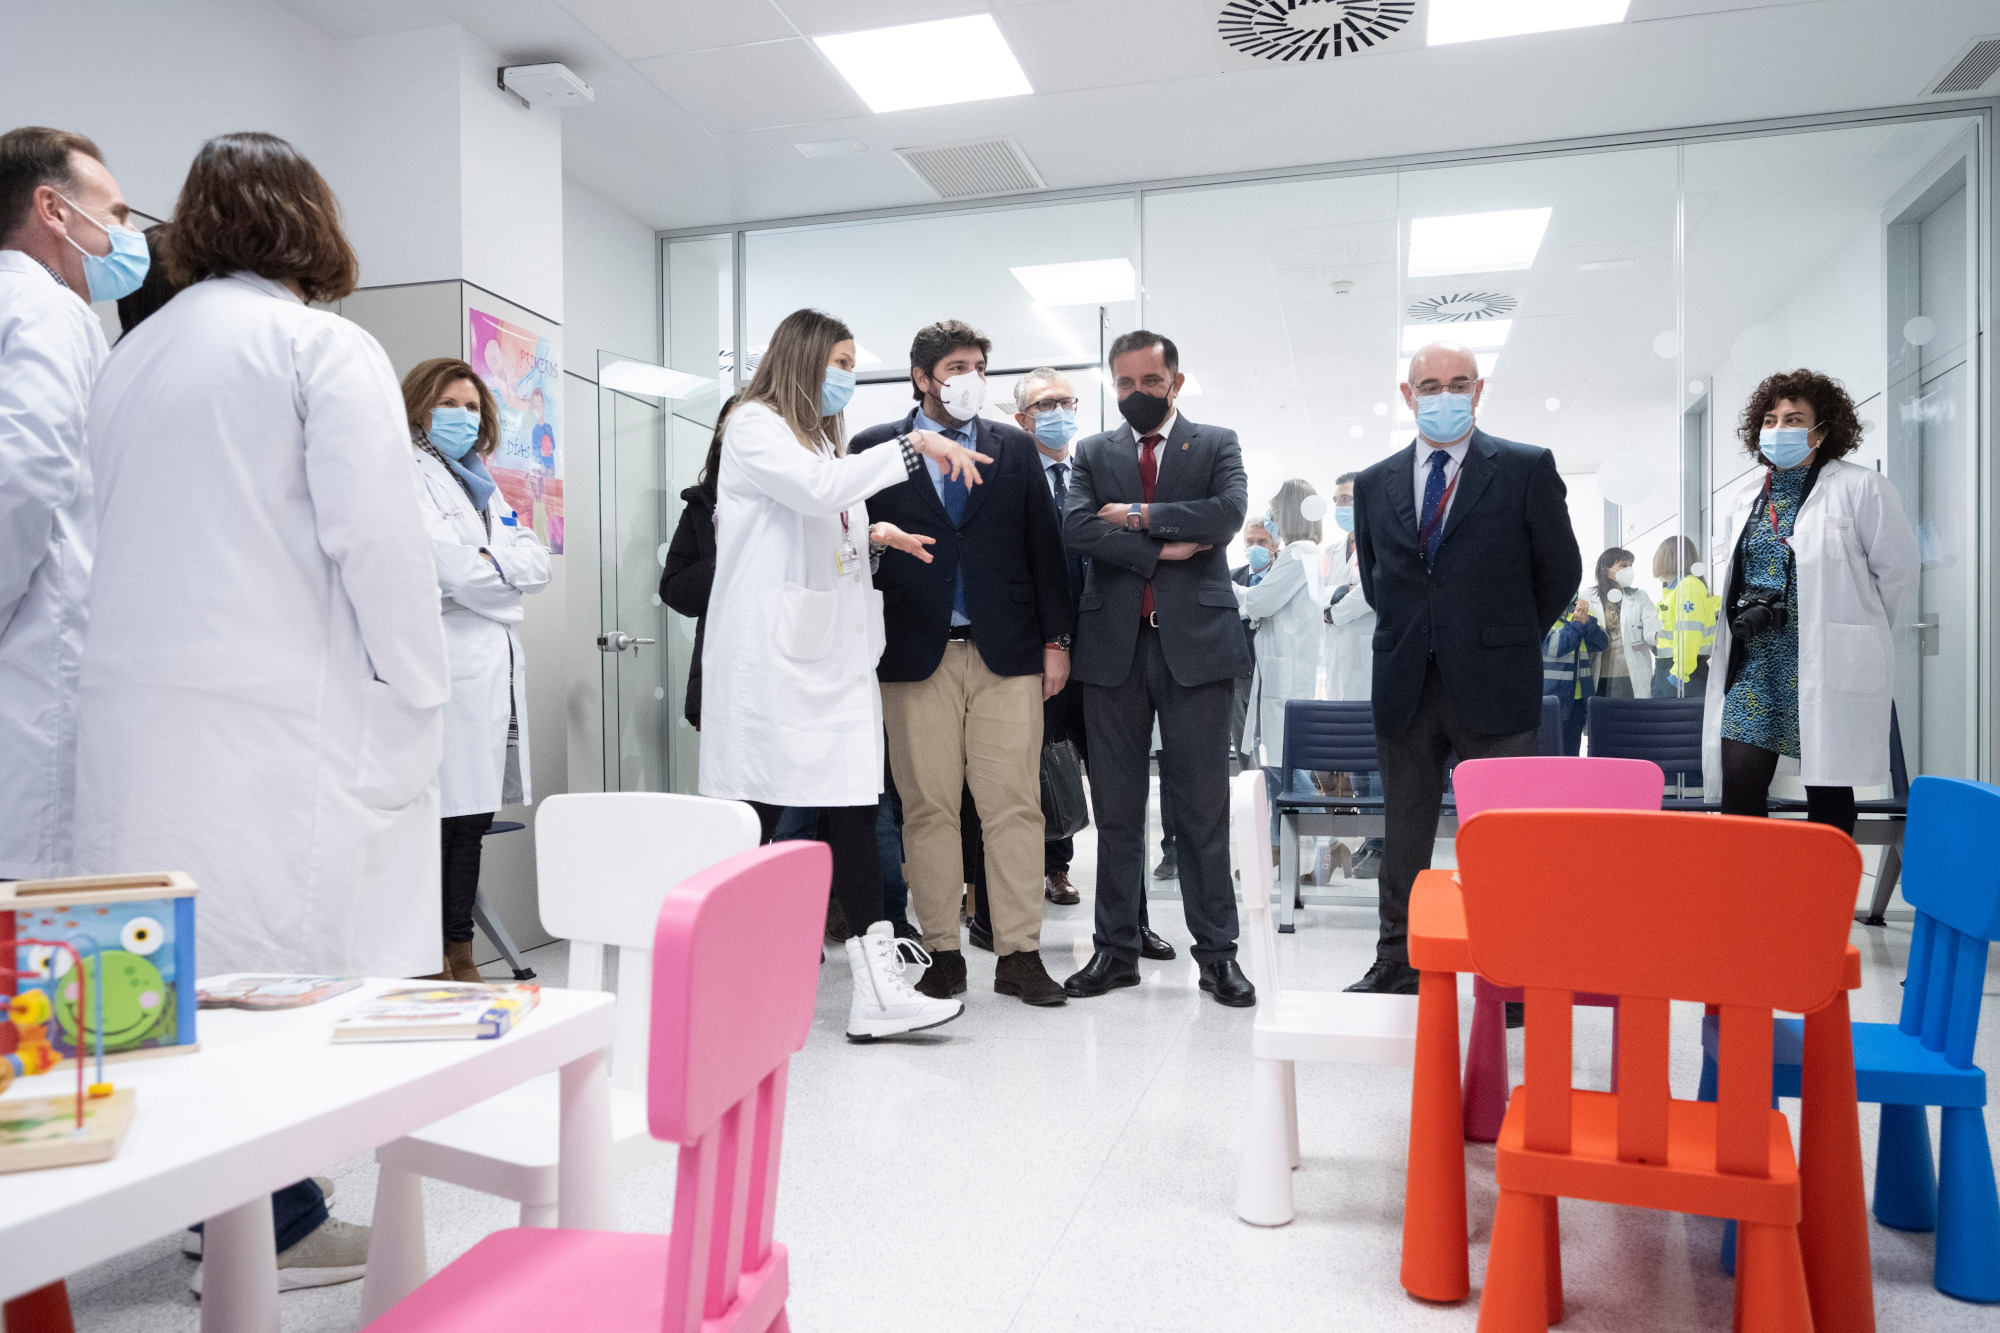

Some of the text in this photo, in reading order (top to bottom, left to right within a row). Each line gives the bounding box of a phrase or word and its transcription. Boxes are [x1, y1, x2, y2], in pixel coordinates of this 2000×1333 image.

[519, 349, 558, 378] PRIMEROS
[506, 438, 531, 459] DÍAS
[1754, 498, 1764, 515] SONY
